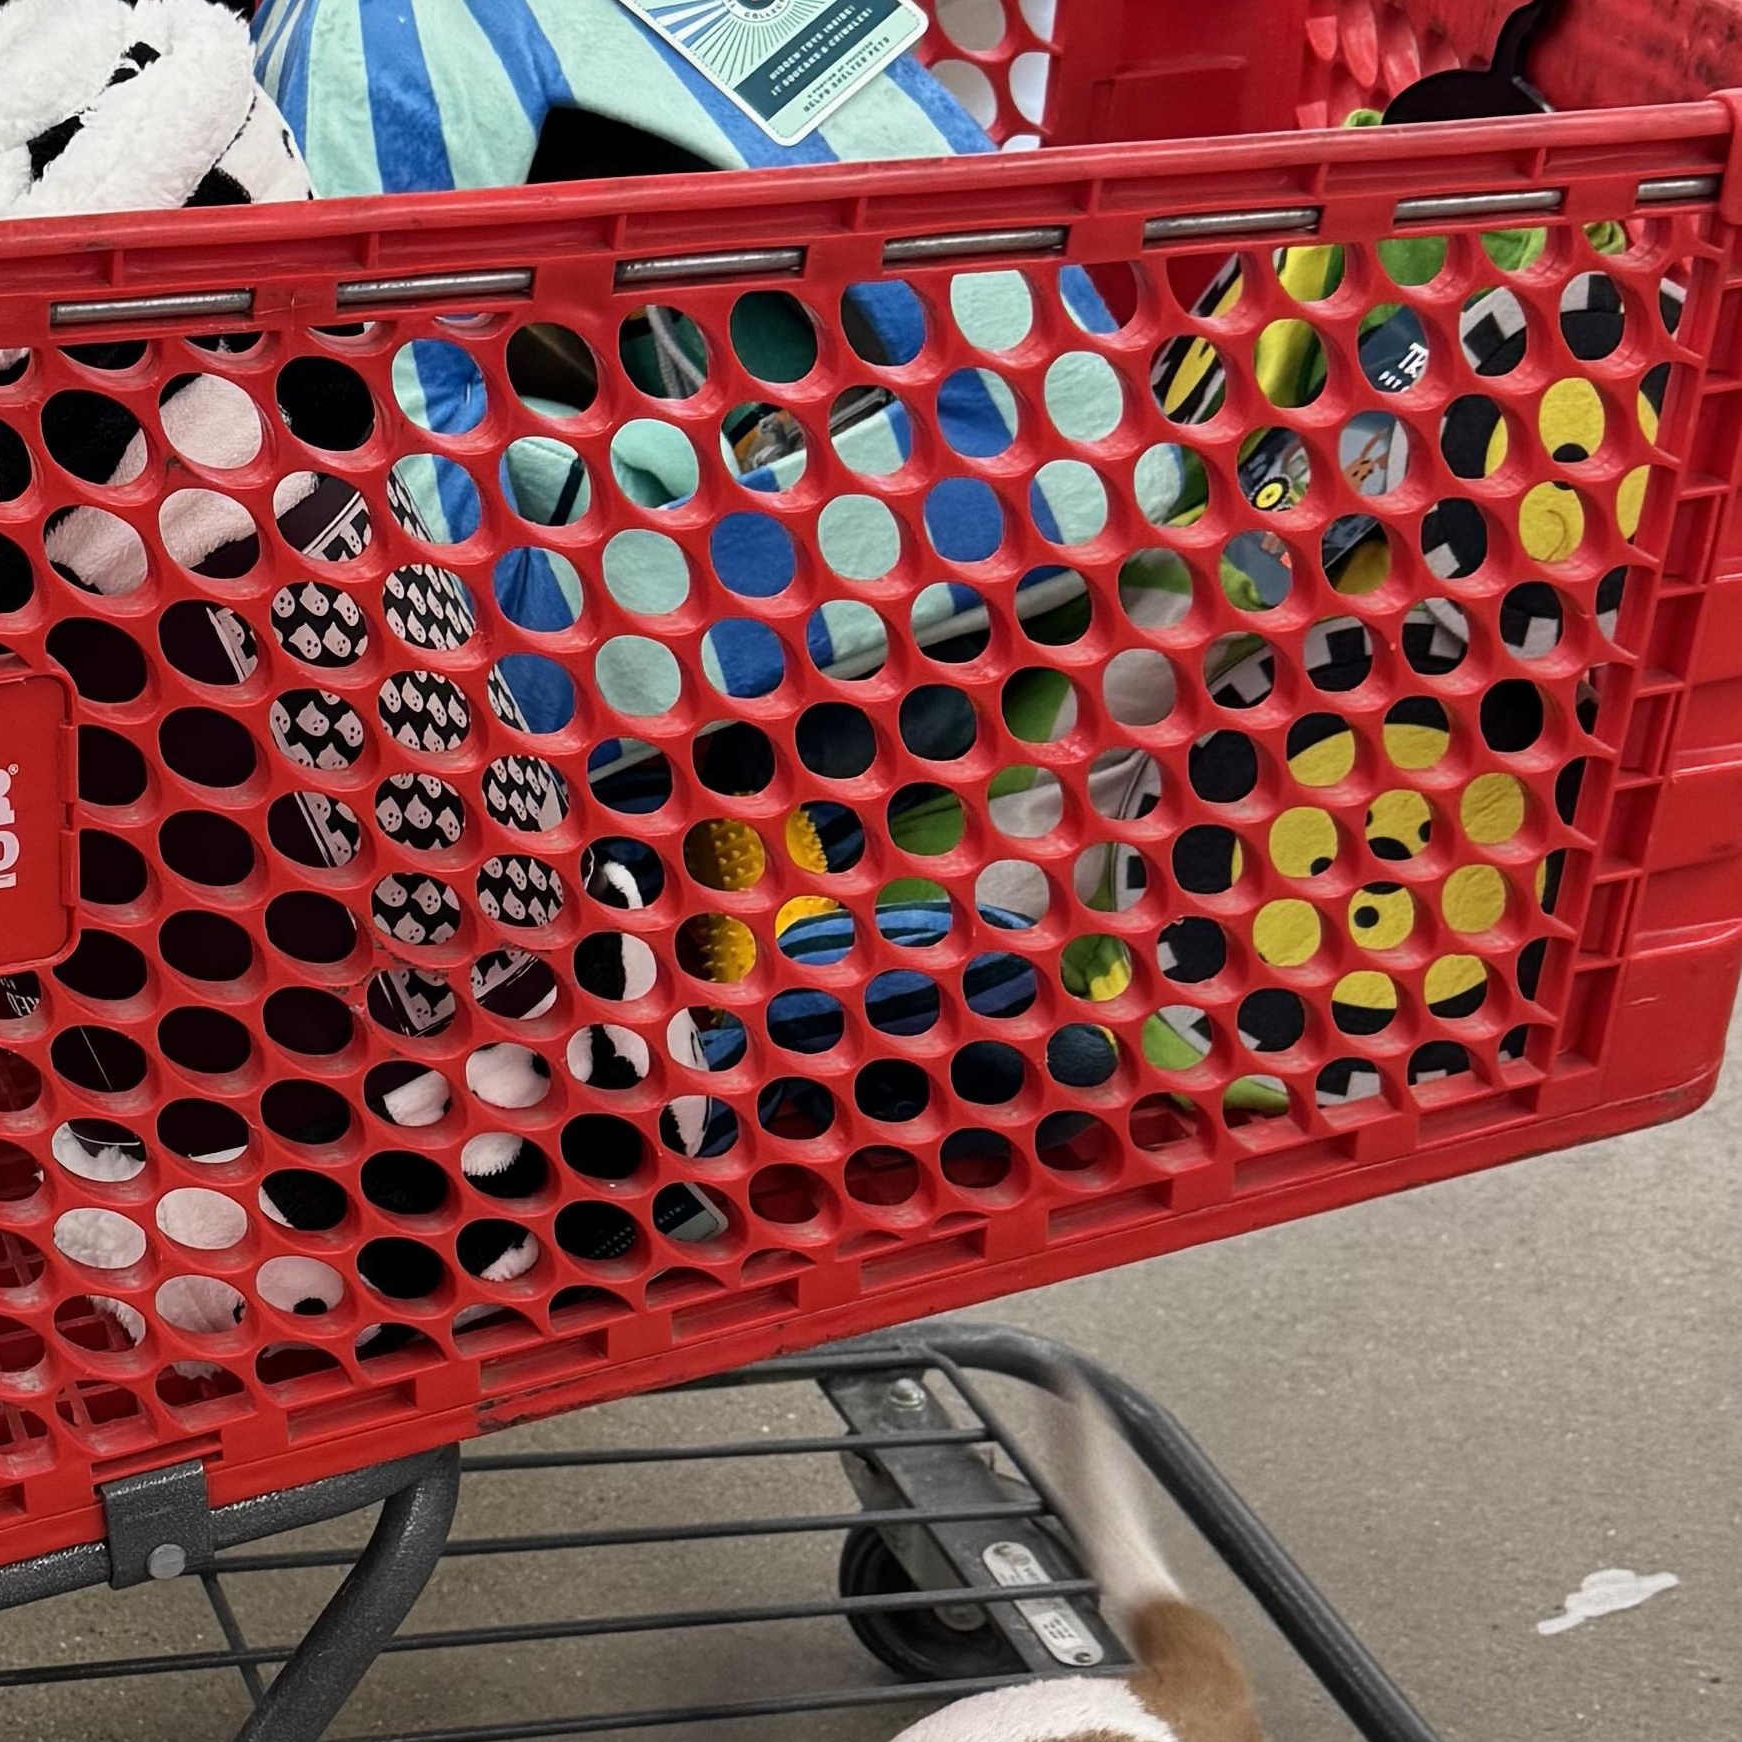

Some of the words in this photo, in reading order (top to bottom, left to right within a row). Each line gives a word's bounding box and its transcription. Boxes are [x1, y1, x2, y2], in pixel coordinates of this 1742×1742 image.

[770, 84, 782, 97] IT
[781, 51, 822, 87] SQUEAKS
[828, 7, 873, 47] CRINKLES!
[800, 32, 824, 53] TOYS
[831, 56, 867, 89] SHELTER
[867, 36, 890, 57] PETS
